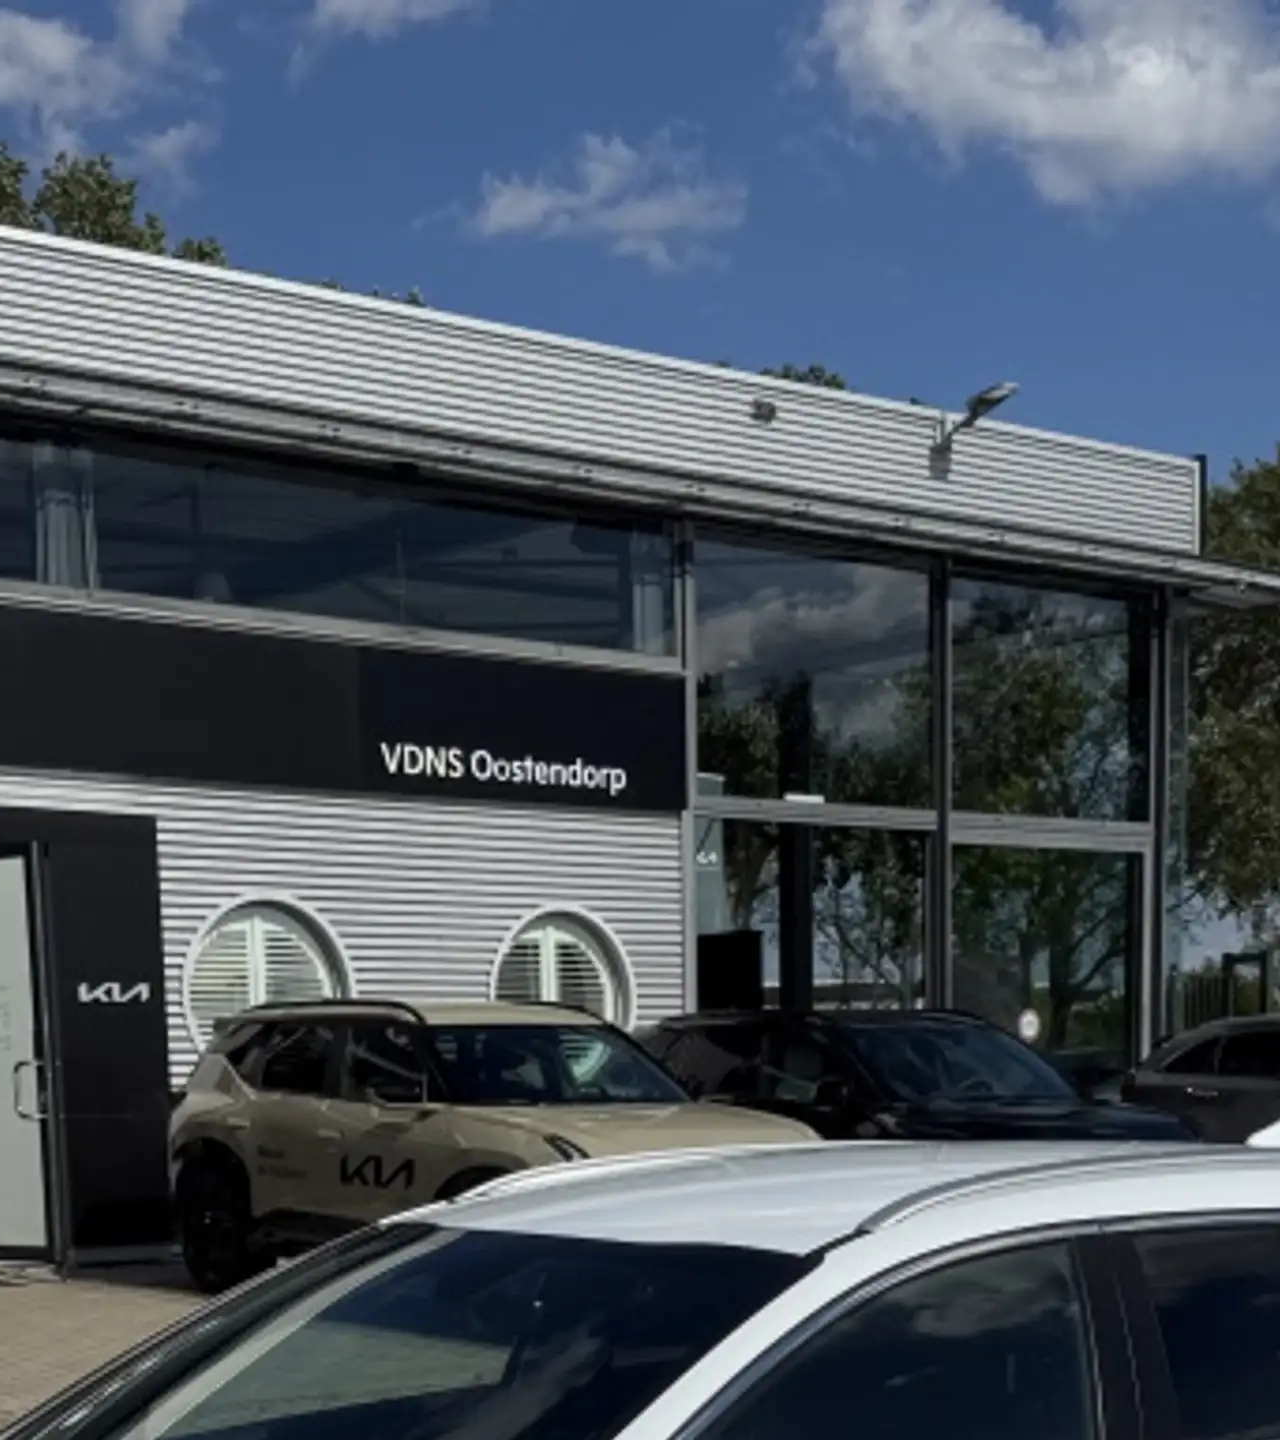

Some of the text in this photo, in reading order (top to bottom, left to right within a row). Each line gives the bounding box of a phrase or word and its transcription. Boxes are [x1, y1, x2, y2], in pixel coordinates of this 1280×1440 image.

[379, 741, 627, 797] VDNS Oostendorp
[77, 981, 150, 1003] KIA
[339, 1153, 417, 1190] KIA
